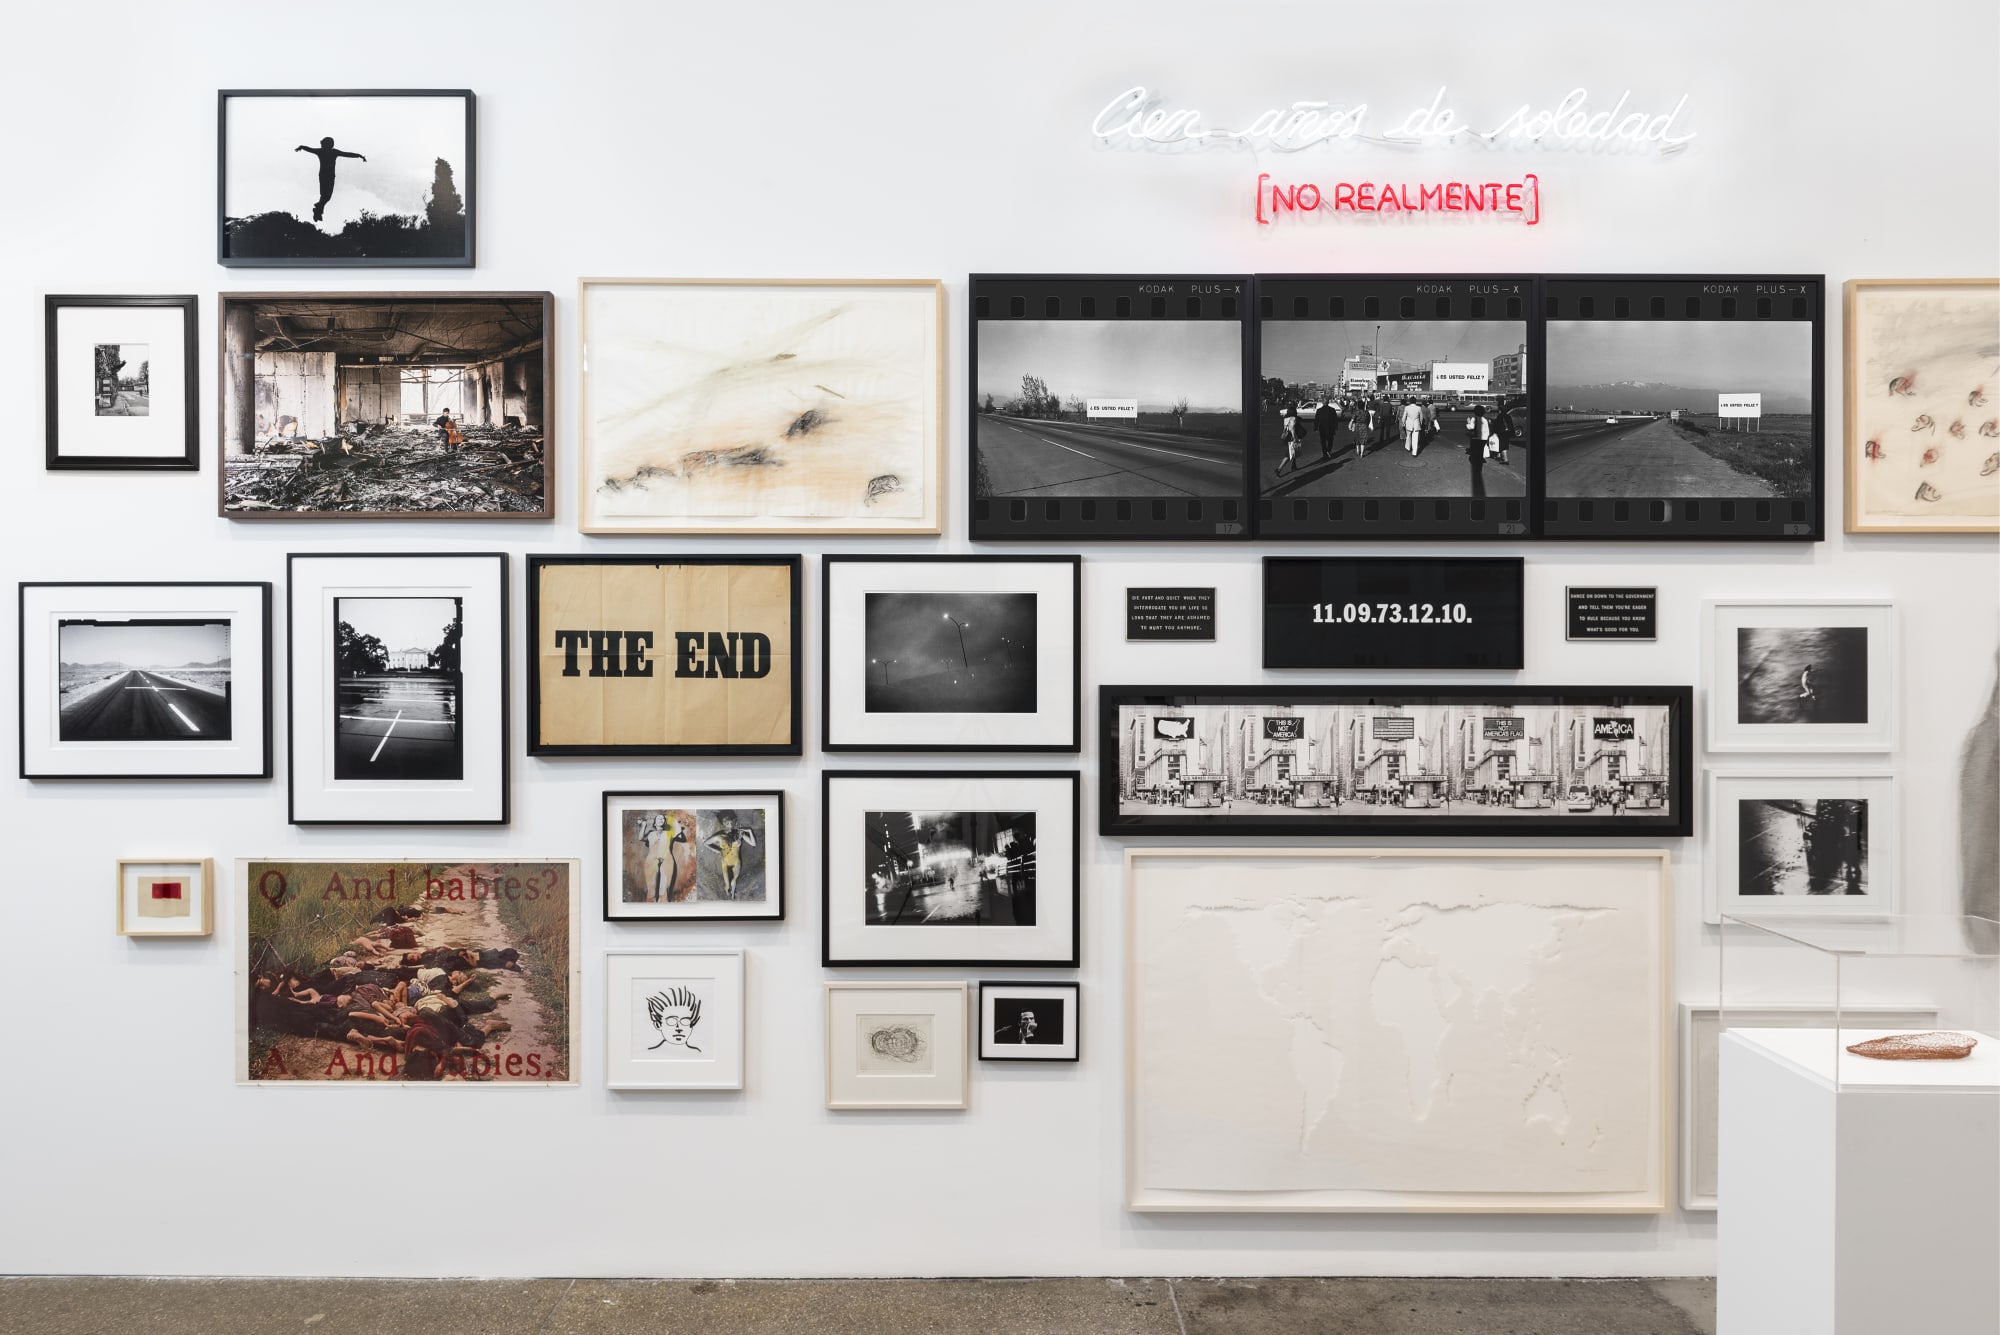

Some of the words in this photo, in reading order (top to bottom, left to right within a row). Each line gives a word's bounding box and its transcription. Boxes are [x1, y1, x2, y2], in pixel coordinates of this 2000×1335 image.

[1091, 85, 1211, 139] Cien
[1230, 101, 1368, 139] años
[1381, 86, 1468, 138] de
[1495, 87, 1696, 143] soledad
[1139, 285, 1174, 294] KODAK
[1416, 285, 1453, 294] KODAK
[1703, 285, 1740, 294] KODAK
[1223, 524, 1233, 534] 17
[1506, 524, 1516, 534] 21
[1793, 524, 1799, 534] 3
[1313, 603, 1472, 624] 11.09.73.12.10.
[555, 630, 653, 677] THE
[675, 632, 771, 678] END
[259, 870, 297, 909] Q.
[323, 869, 396, 900] And
[425, 868, 559, 901] babies?
[262, 1050, 298, 1076] A.
[326, 1048, 398, 1077] And
